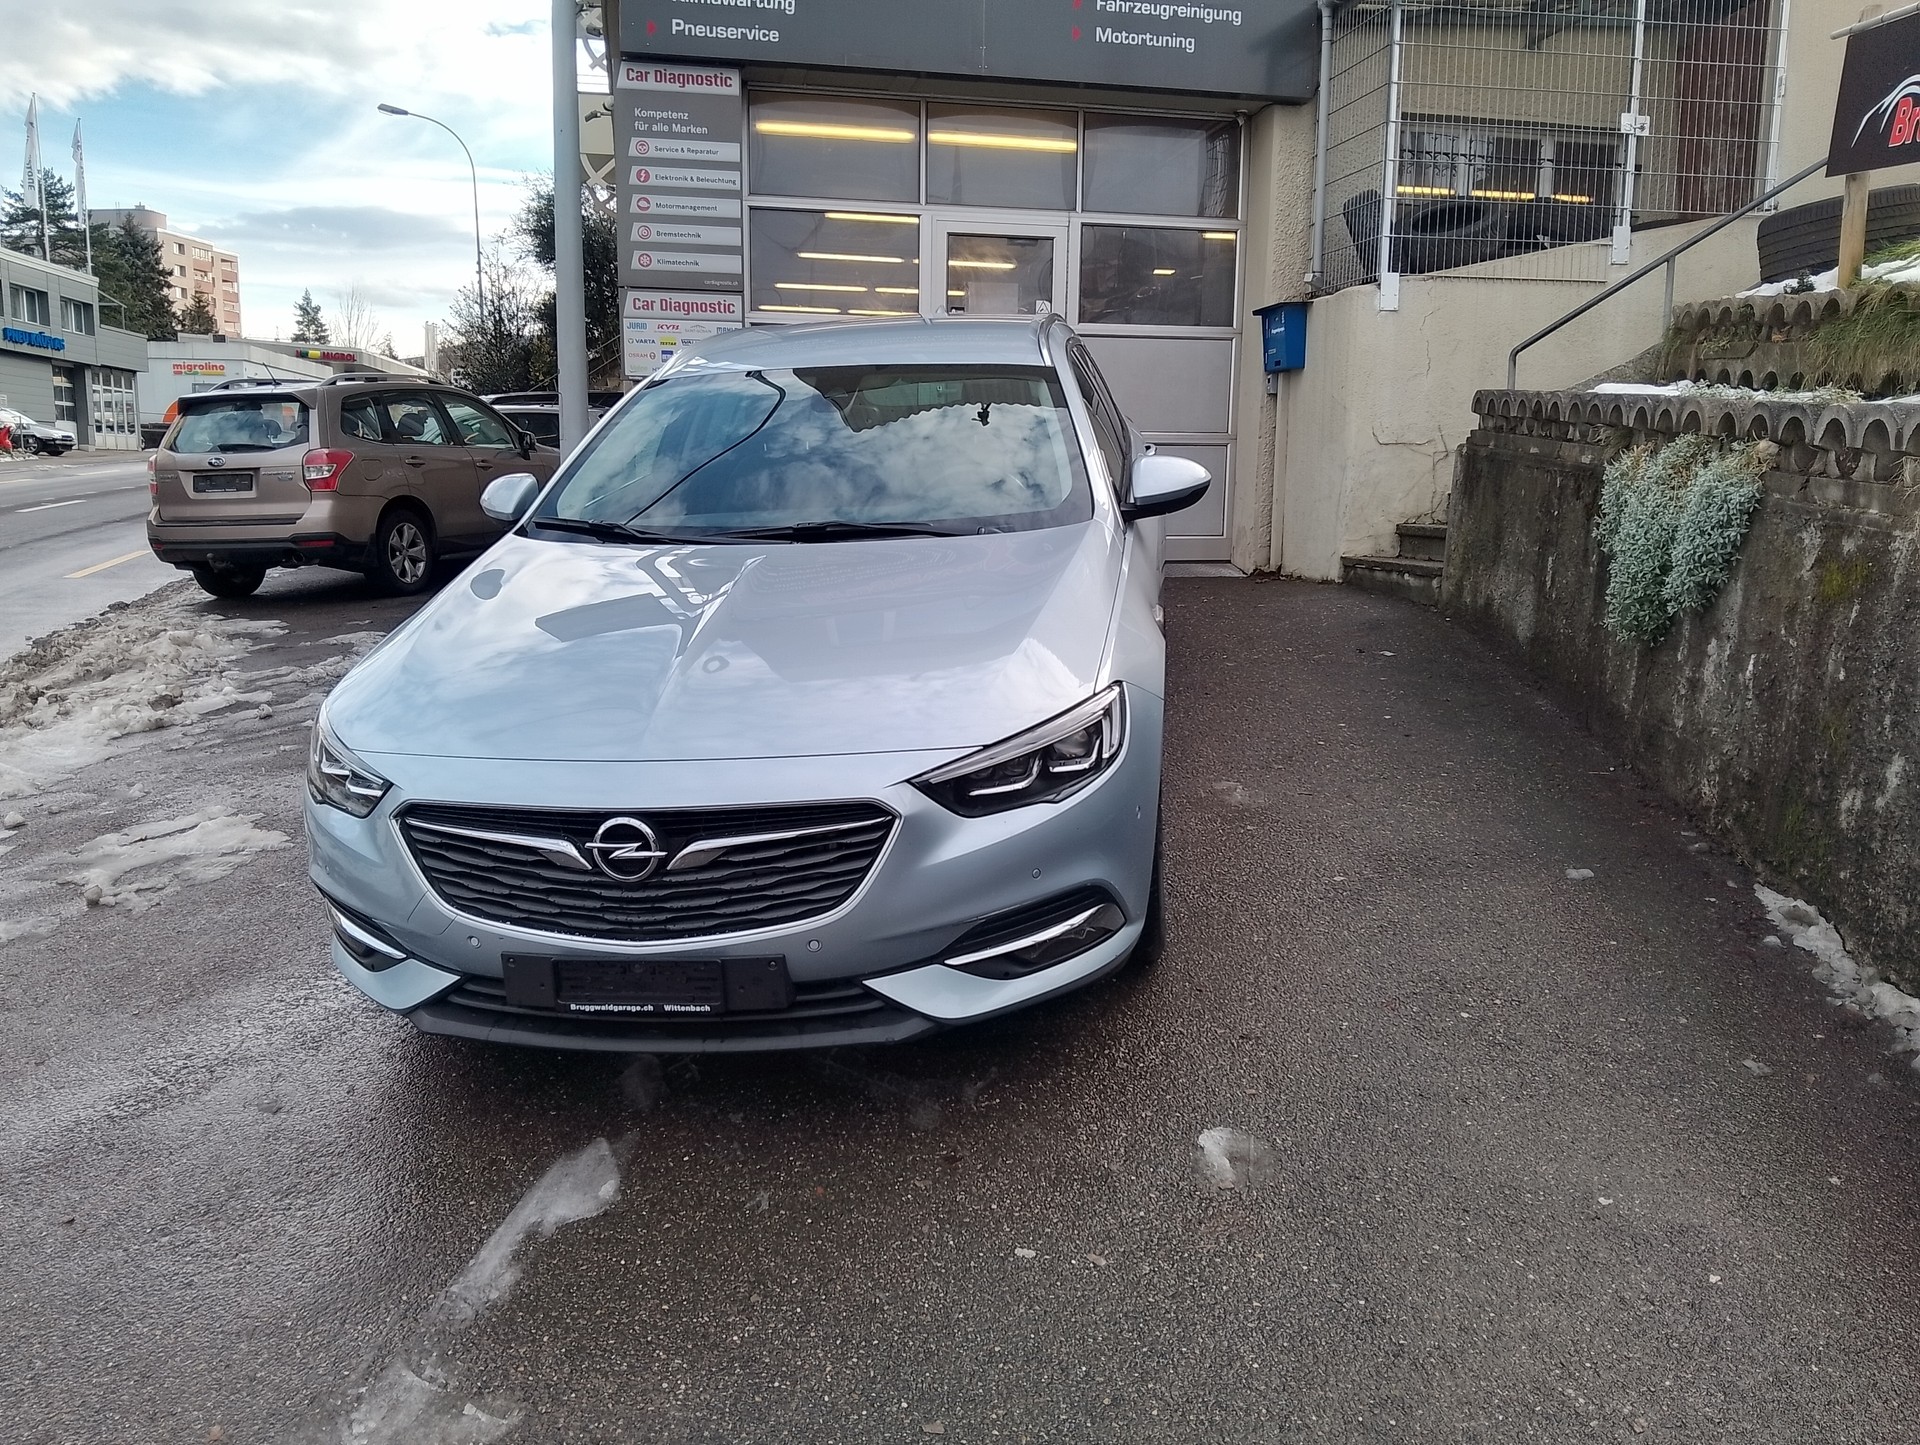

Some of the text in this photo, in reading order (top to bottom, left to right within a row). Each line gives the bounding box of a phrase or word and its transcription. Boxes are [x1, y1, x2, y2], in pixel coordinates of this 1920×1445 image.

[1096, 0, 1242, 26] Fahrzeugreinigung
[671, 18, 780, 42] Pneuservice
[1095, 26, 1196, 53] Motortuning
[626, 67, 733, 88] Car Diagnostic
[634, 107, 689, 120] Kompetenz
[634, 121, 708, 134] für alle Marken
[1888, 96, 1920, 148] Br
[654, 145, 679, 154] Service
[686, 147, 719, 156] Reparatur
[655, 173, 688, 182] Elektronik
[696, 176, 737, 186] Beleuchtung
[655, 202, 718, 212] Motormanagement
[656, 230, 702, 239] Bremstechnik
[656, 258, 700, 267] Klimatechnik
[632, 297, 736, 316] Car Diagnostic
[626, 322, 648, 330] JURID
[322, 351, 358, 363] MIGROL
[172, 361, 225, 374] migrolino
[570, 1003, 711, 1012] Bruggwaldgarage.ch Wittenbach
